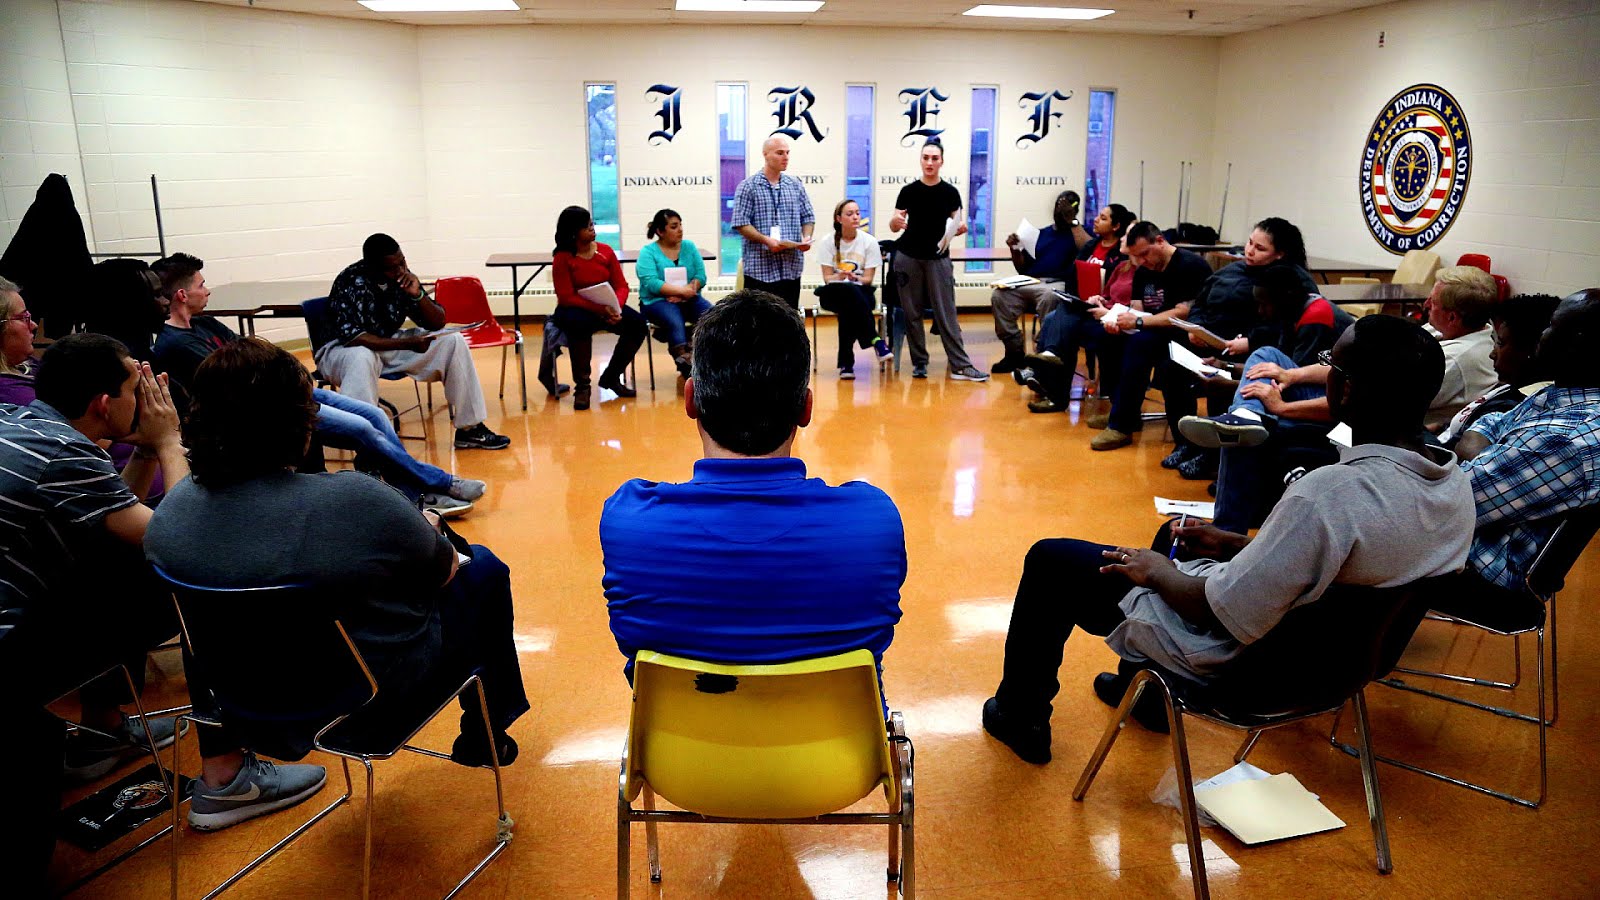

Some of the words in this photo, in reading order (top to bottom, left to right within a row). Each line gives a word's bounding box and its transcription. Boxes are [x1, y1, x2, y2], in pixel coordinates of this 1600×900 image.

[767, 85, 829, 143] R
[898, 86, 950, 148] E
[1016, 89, 1073, 150] F
[1394, 91, 1443, 115] INDIANA
[624, 175, 713, 187] INDIANAPOLIS
[1015, 175, 1068, 186] FACILITY
[1362, 146, 1395, 246] DEPARTMENT
[1397, 237, 1412, 250] OF
[1416, 146, 1468, 248] CORRECTION
